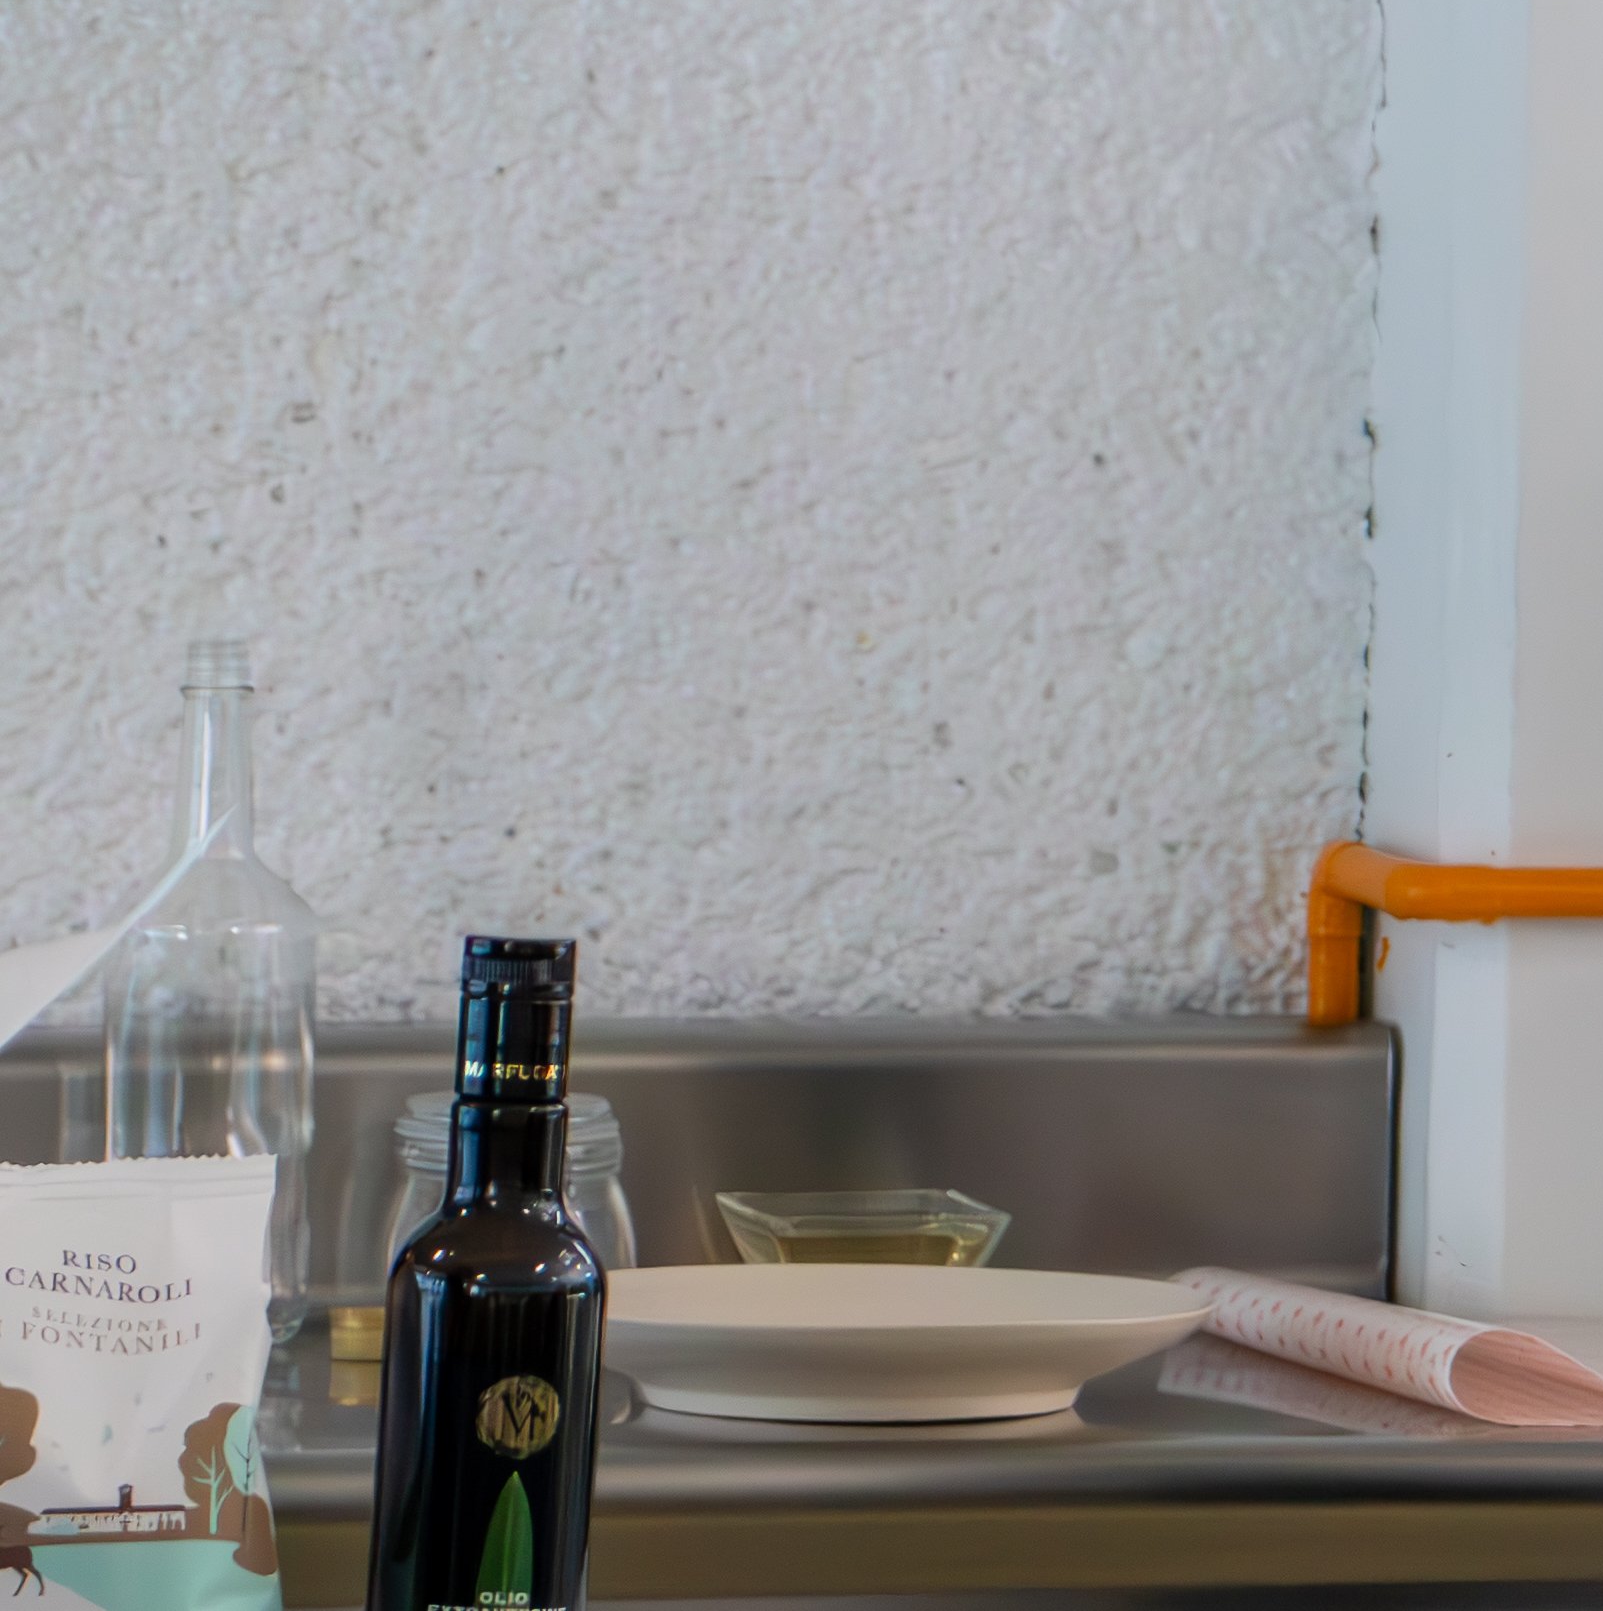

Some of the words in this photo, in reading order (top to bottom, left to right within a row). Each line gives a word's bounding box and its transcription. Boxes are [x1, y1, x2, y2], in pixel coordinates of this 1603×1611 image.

[62, 1249, 137, 1275] RISO
[5, 1266, 193, 1304] CARNAROLI
[32, 1306, 168, 1332] SELEZIONE
[479, 1591, 529, 1605] OLIO
